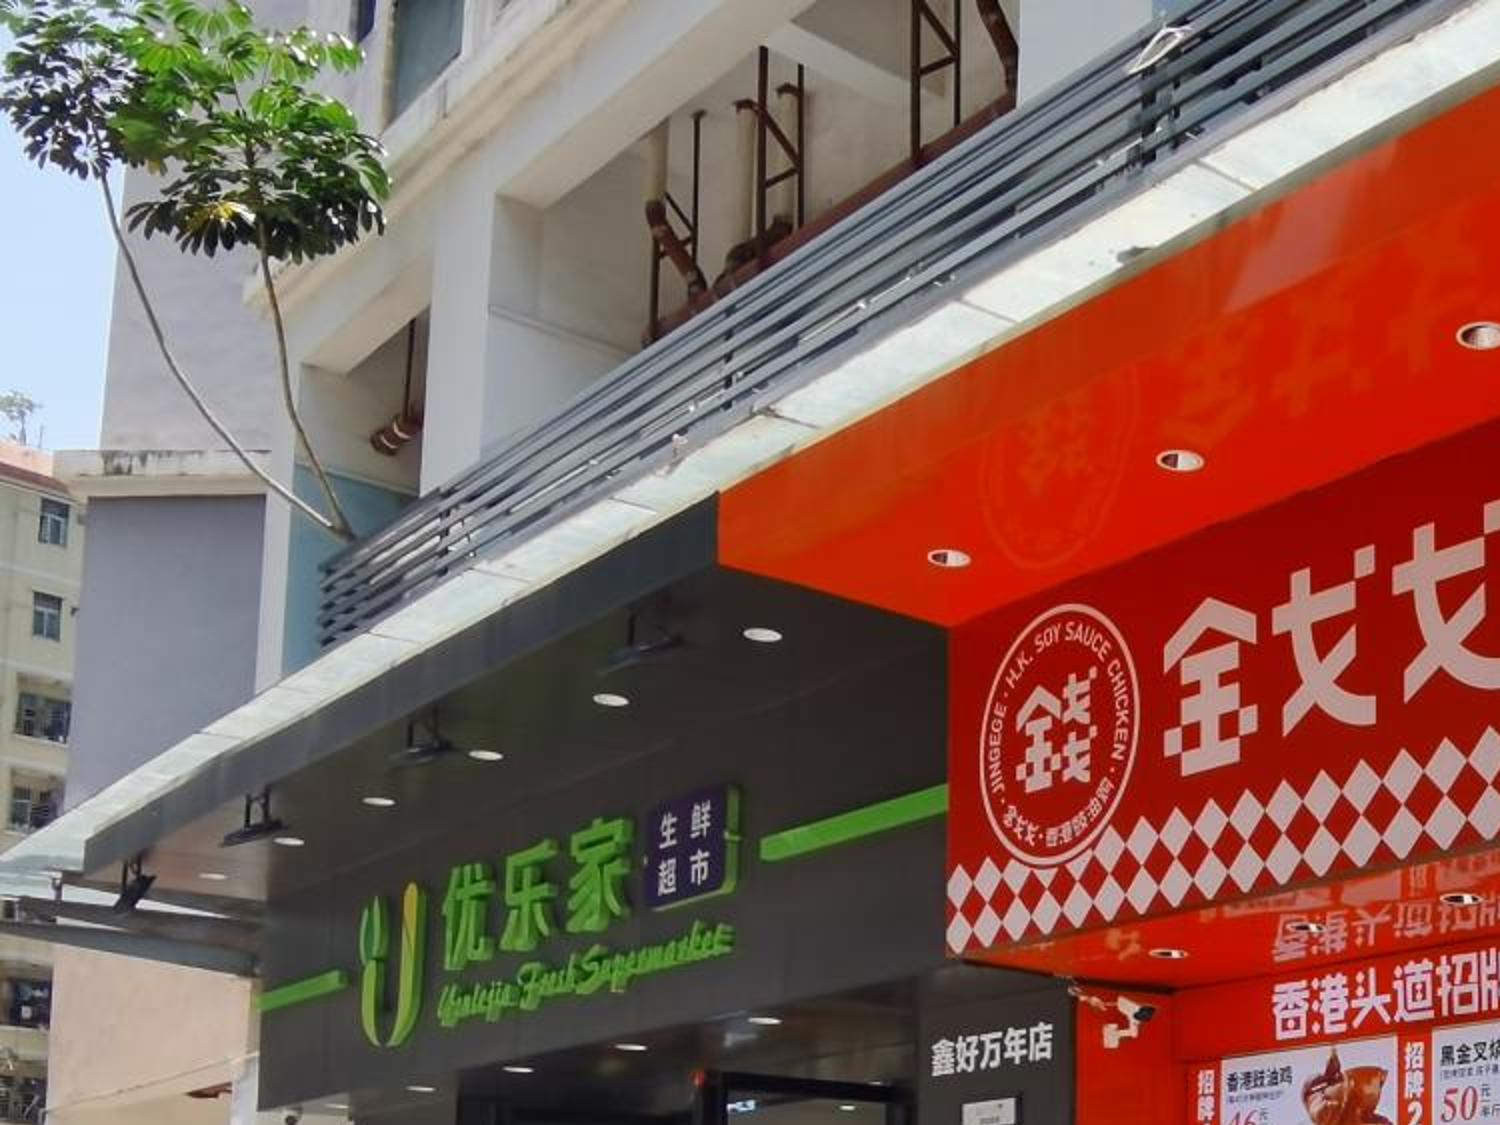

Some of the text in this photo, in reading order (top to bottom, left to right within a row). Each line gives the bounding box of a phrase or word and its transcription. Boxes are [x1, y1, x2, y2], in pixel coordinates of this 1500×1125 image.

[988, 704, 1009, 794] JINGEGE
[1034, 622, 1062, 653] SOY
[1064, 621, 1111, 662] SAUCE
[1107, 658, 1130, 761] CHICKEN
[658, 800, 712, 849] 生鲜
[442, 818, 635, 971] 优乐家
[656, 849, 711, 897] 超市
[931, 1022, 1053, 1077] 鑫好万年店
[1441, 1086, 1478, 1122] 50
